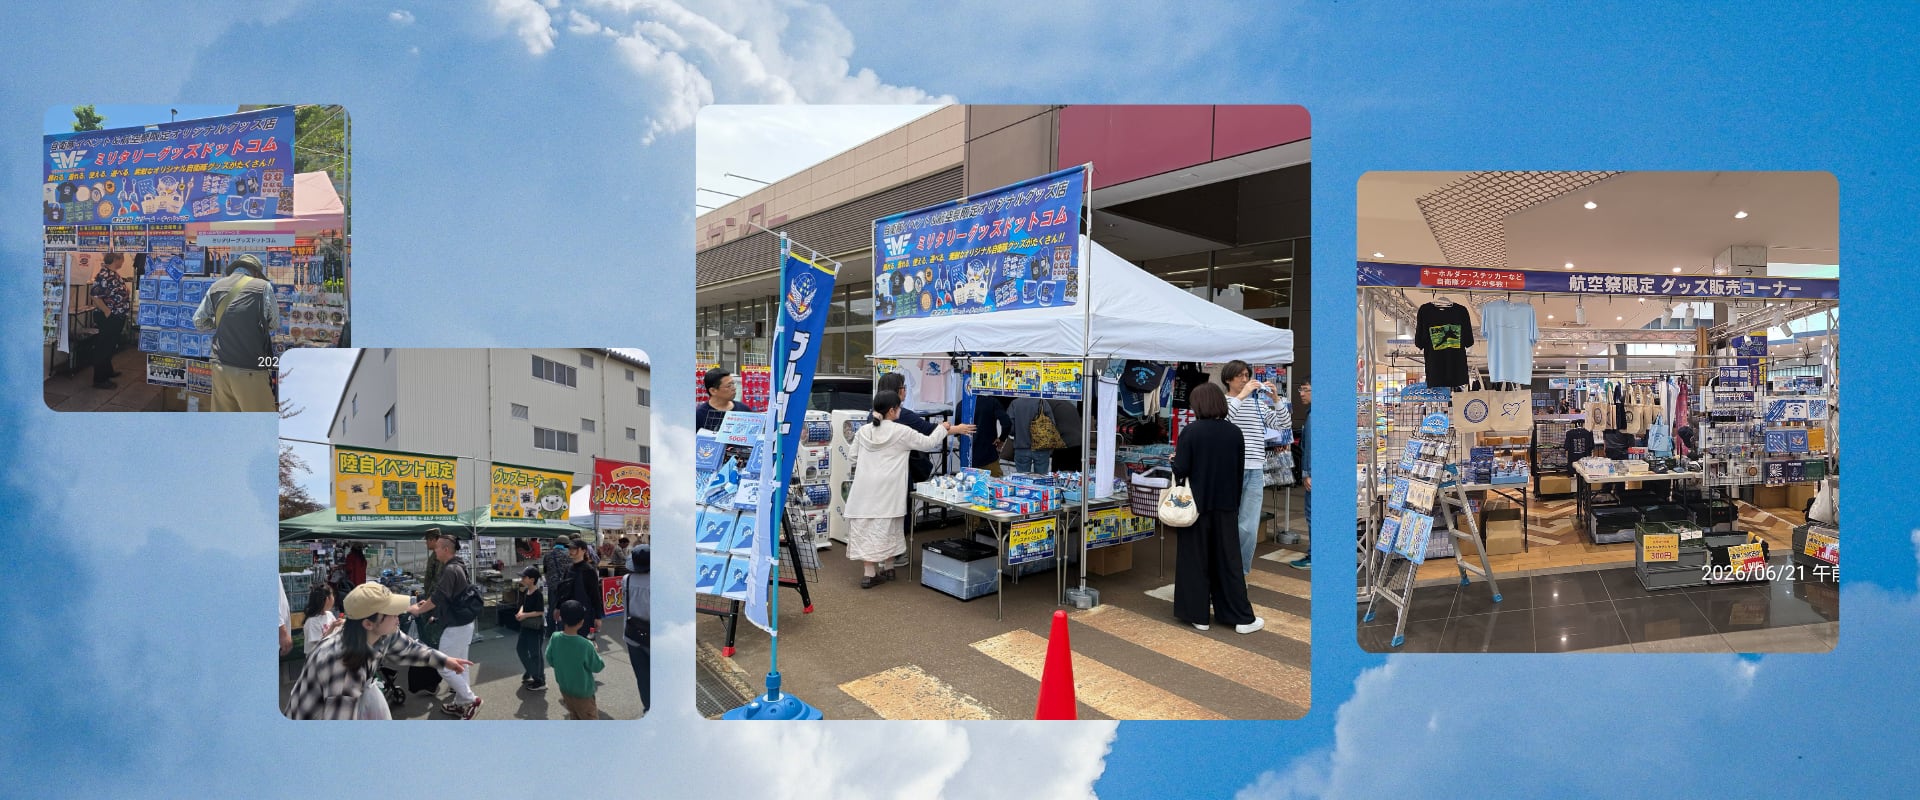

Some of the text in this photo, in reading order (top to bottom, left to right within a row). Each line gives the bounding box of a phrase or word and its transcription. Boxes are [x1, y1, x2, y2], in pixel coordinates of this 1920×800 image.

[94, 136, 278, 166] ミリタリーグッズドットコム
[696, 203, 788, 250] センター
[916, 205, 1068, 251] ミリタリーグッズドットコム
[1423, 269, 1523, 280] キーホルダー・ステッカーなど
[1568, 274, 1802, 295] 航空祭限定 グッズ販売コーナー
[729, 435, 747, 443] 500円
[339, 452, 454, 480] 陸自イベント限定
[493, 467, 550, 488] グッズコーナー
[1651, 551, 1672, 560] 300円
